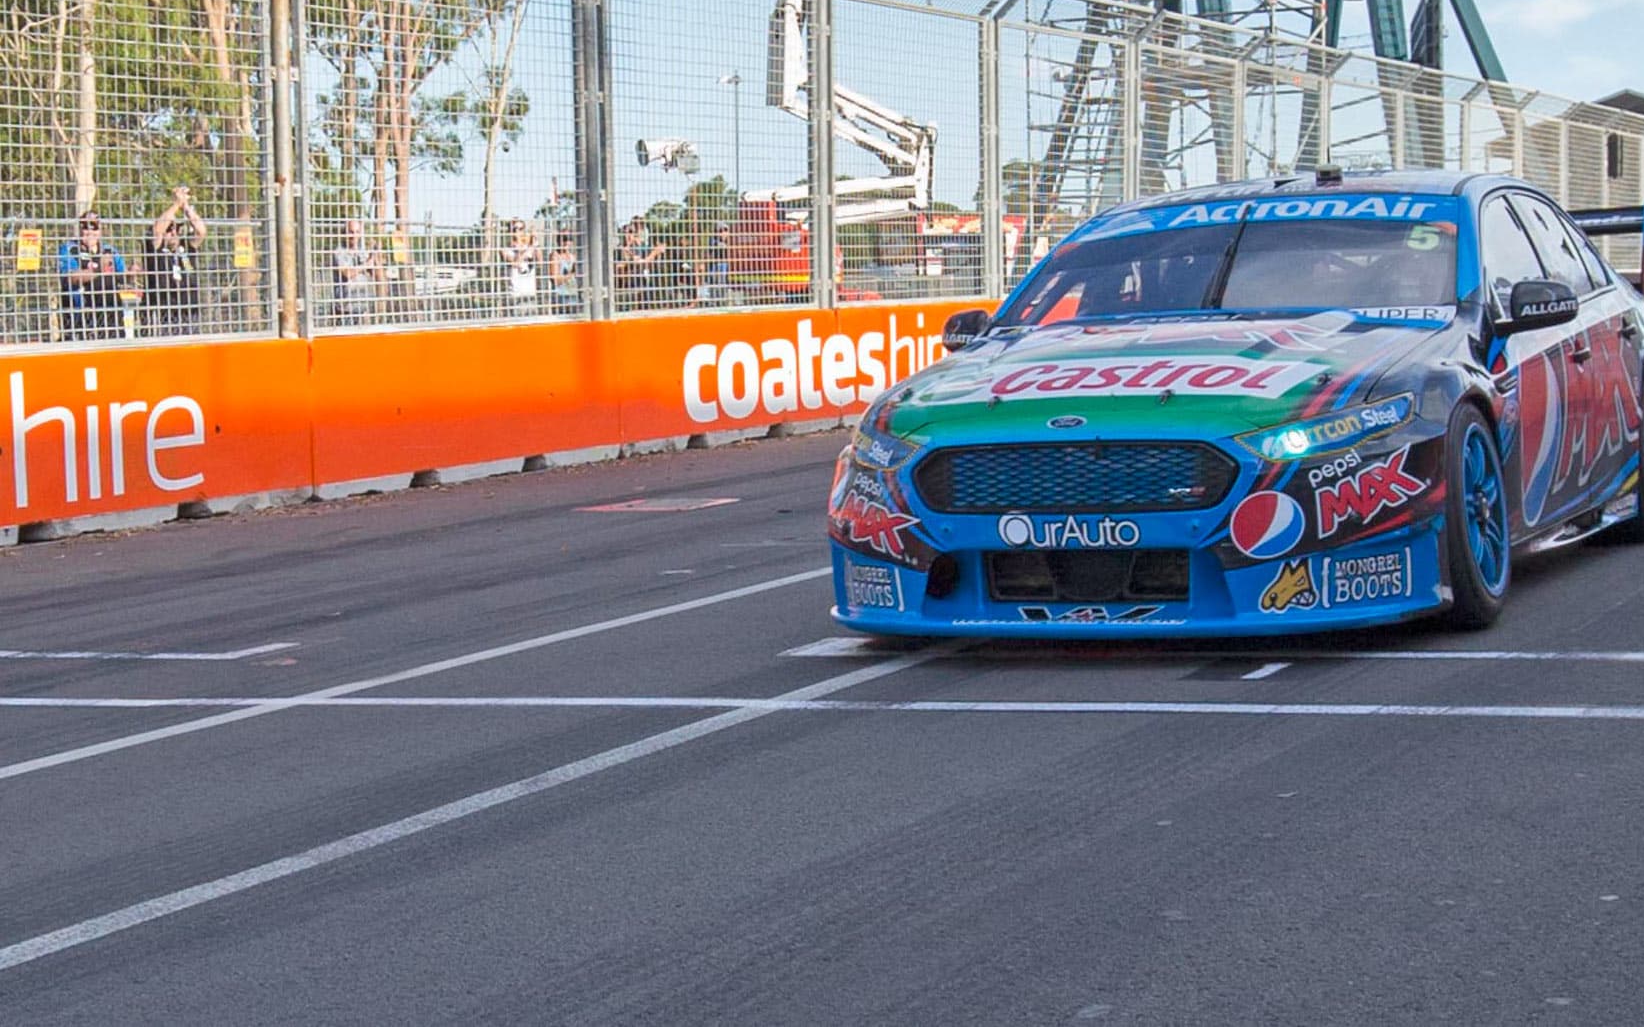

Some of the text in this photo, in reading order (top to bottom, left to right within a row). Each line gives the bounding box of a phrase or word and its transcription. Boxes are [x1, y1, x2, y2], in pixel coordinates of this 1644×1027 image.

[1168, 196, 1436, 228] ActronAir
[1406, 225, 1441, 252] 5
[1351, 308, 1440, 321] UPER
[1520, 298, 1579, 317] ALLGATE
[683, 312, 949, 423] coateshir
[990, 359, 1279, 396] Castrol
[1361, 404, 1401, 429] Steel
[9, 367, 206, 509] hire
[853, 471, 884, 497] pepsi
[1308, 448, 1362, 489] pepsi
[1315, 442, 1427, 540] MAX
[998, 511, 1141, 548] OurAuto
[1334, 553, 1403, 578] MONGREL
[1334, 569, 1403, 604] BOOTS
